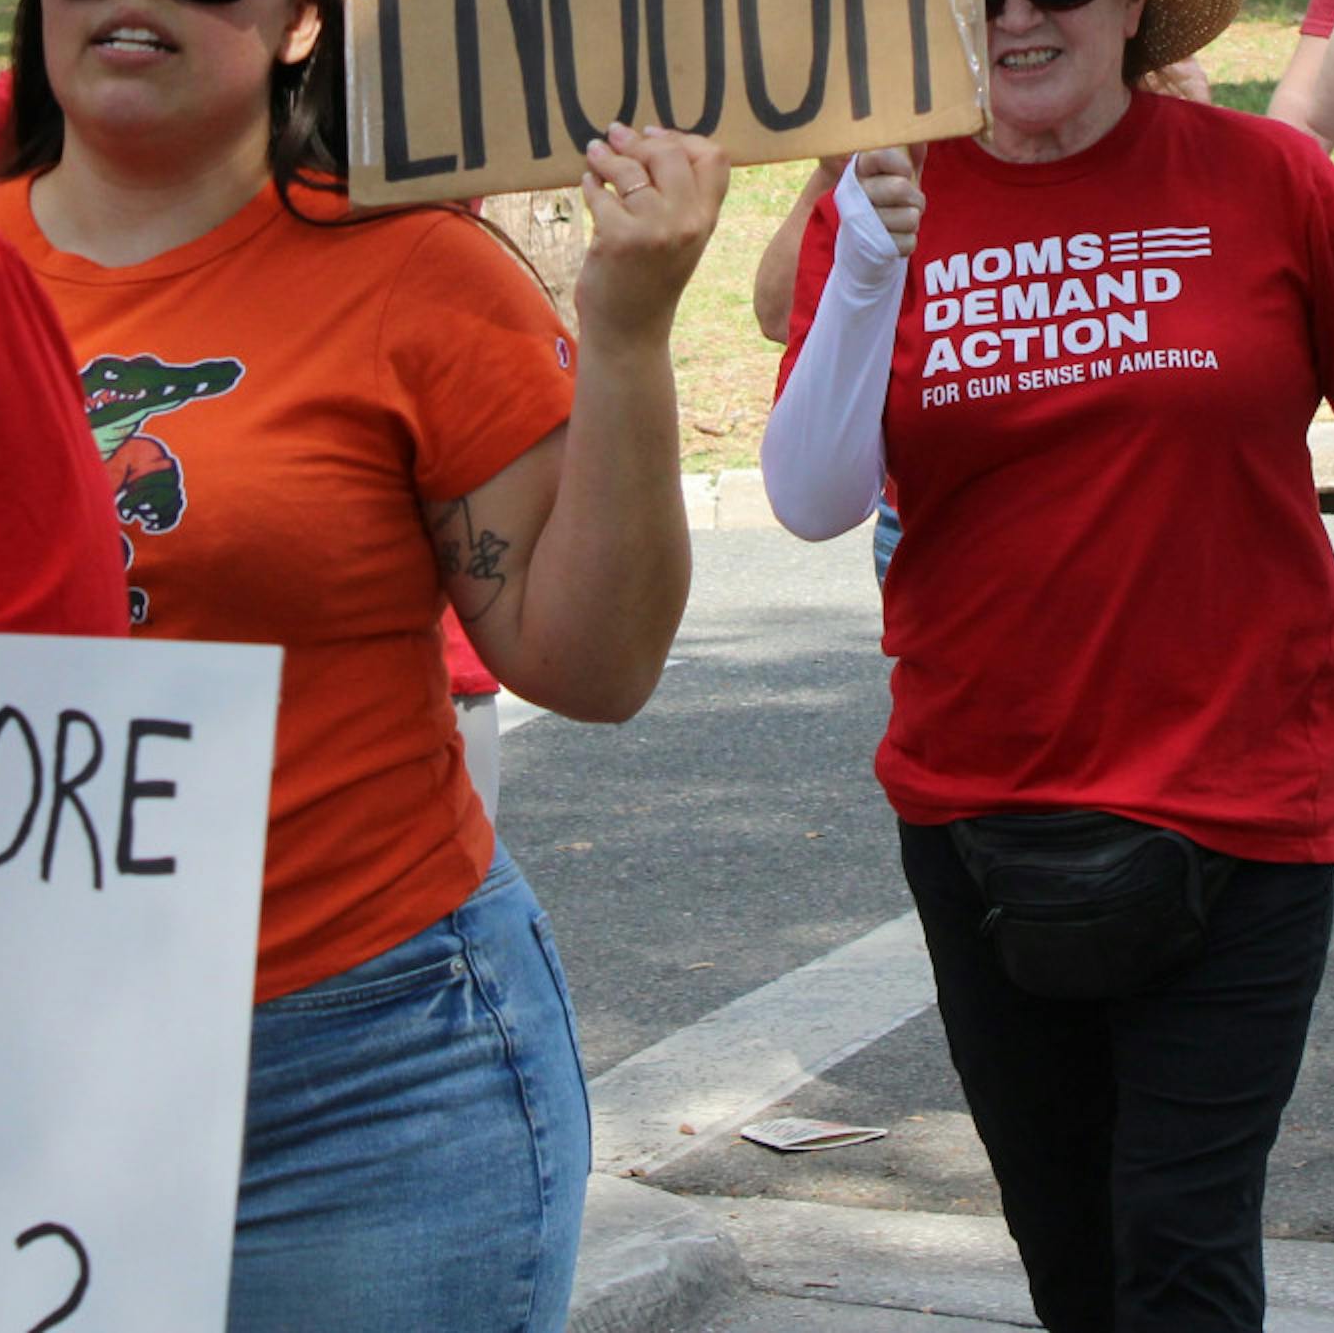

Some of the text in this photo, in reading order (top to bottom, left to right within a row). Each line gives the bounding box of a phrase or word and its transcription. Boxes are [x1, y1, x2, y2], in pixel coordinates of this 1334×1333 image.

[923, 233, 1105, 296] MOMS
[923, 267, 1182, 333] DEMAND
[922, 309, 1149, 378] ACTION
[922, 349, 1219, 409] FOR GUN SENSE IN AMERICA
